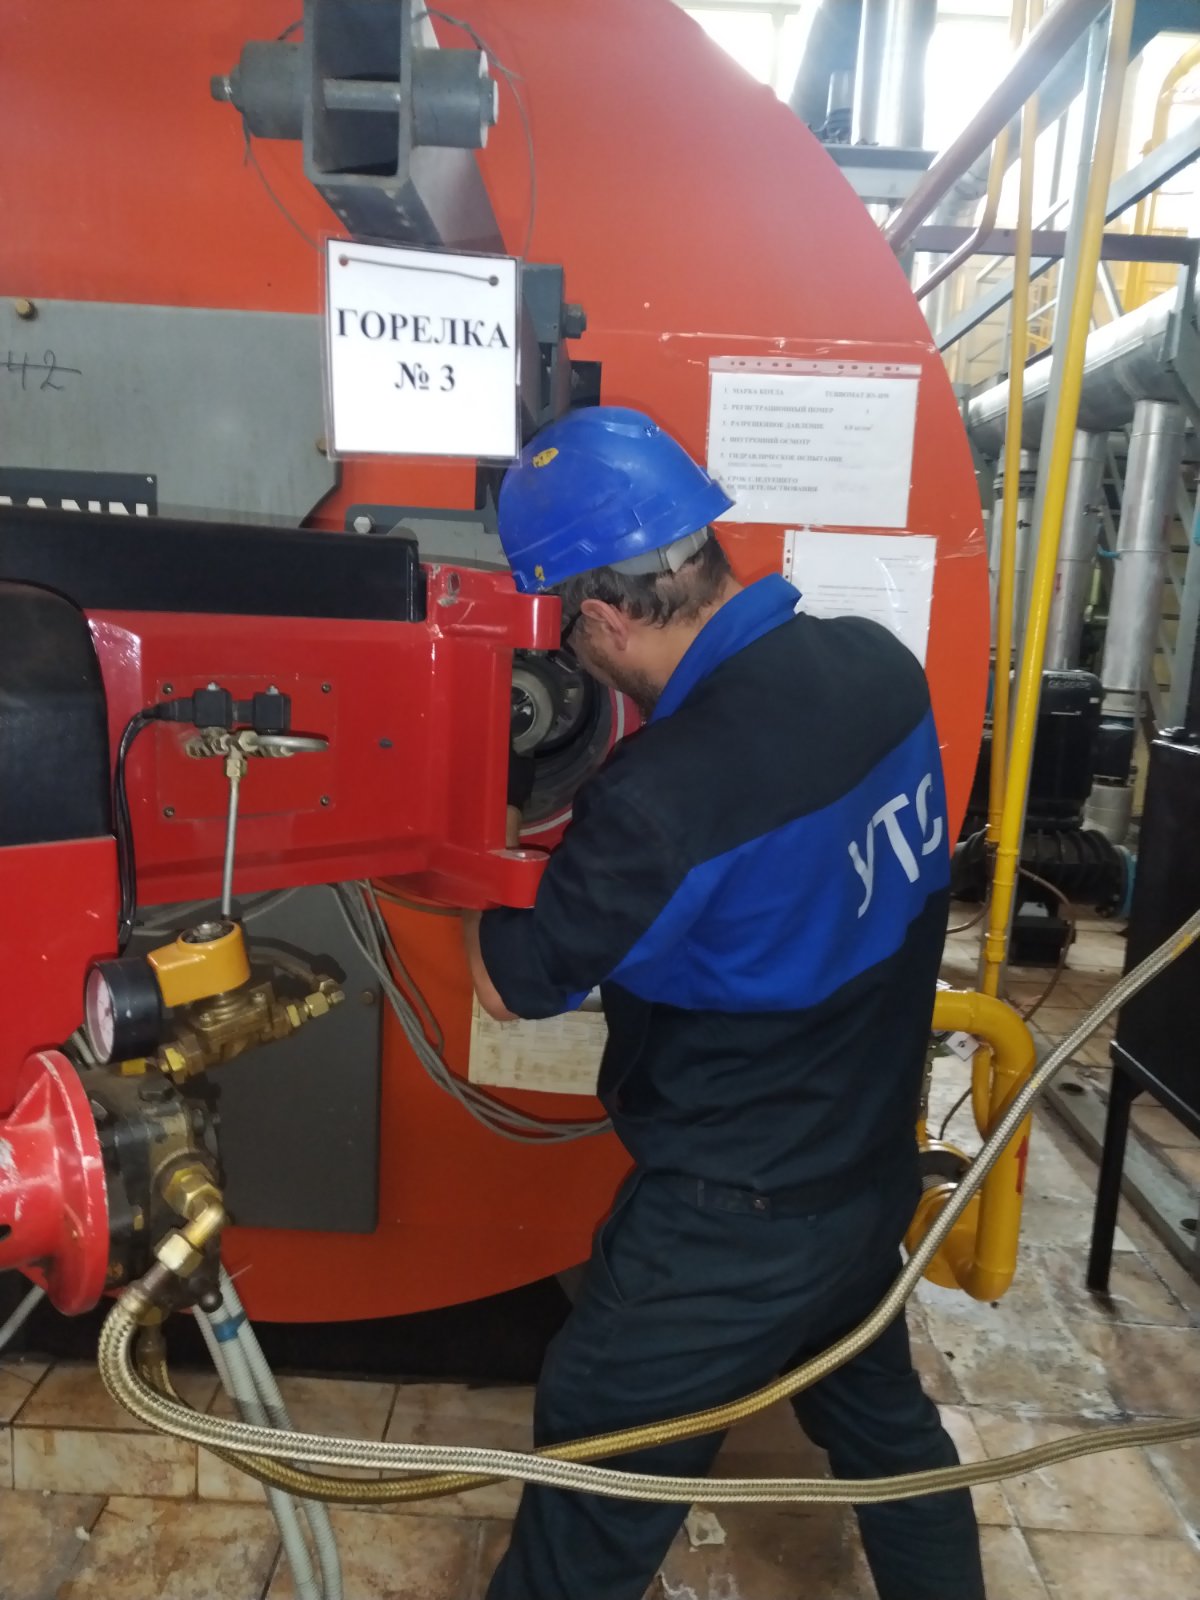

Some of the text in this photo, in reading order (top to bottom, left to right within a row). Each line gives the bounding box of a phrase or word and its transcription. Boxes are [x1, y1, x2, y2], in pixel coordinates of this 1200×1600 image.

[336, 307, 510, 349] ГОРЕЛКА
[395, 361, 456, 392] № 3
[732, 387, 758, 395] МАРКА
[731, 404, 807, 413] РЕГИСТРАЦИОННЫЙ
[785, 422, 825, 430] ДАВЛЕНИЕ
[729, 436, 779, 445] ВНУТРЕННИЙ
[728, 452, 795, 461] ГИДРАВЛИЧЕСКОЕ
[847, 773, 943, 919] УТС
